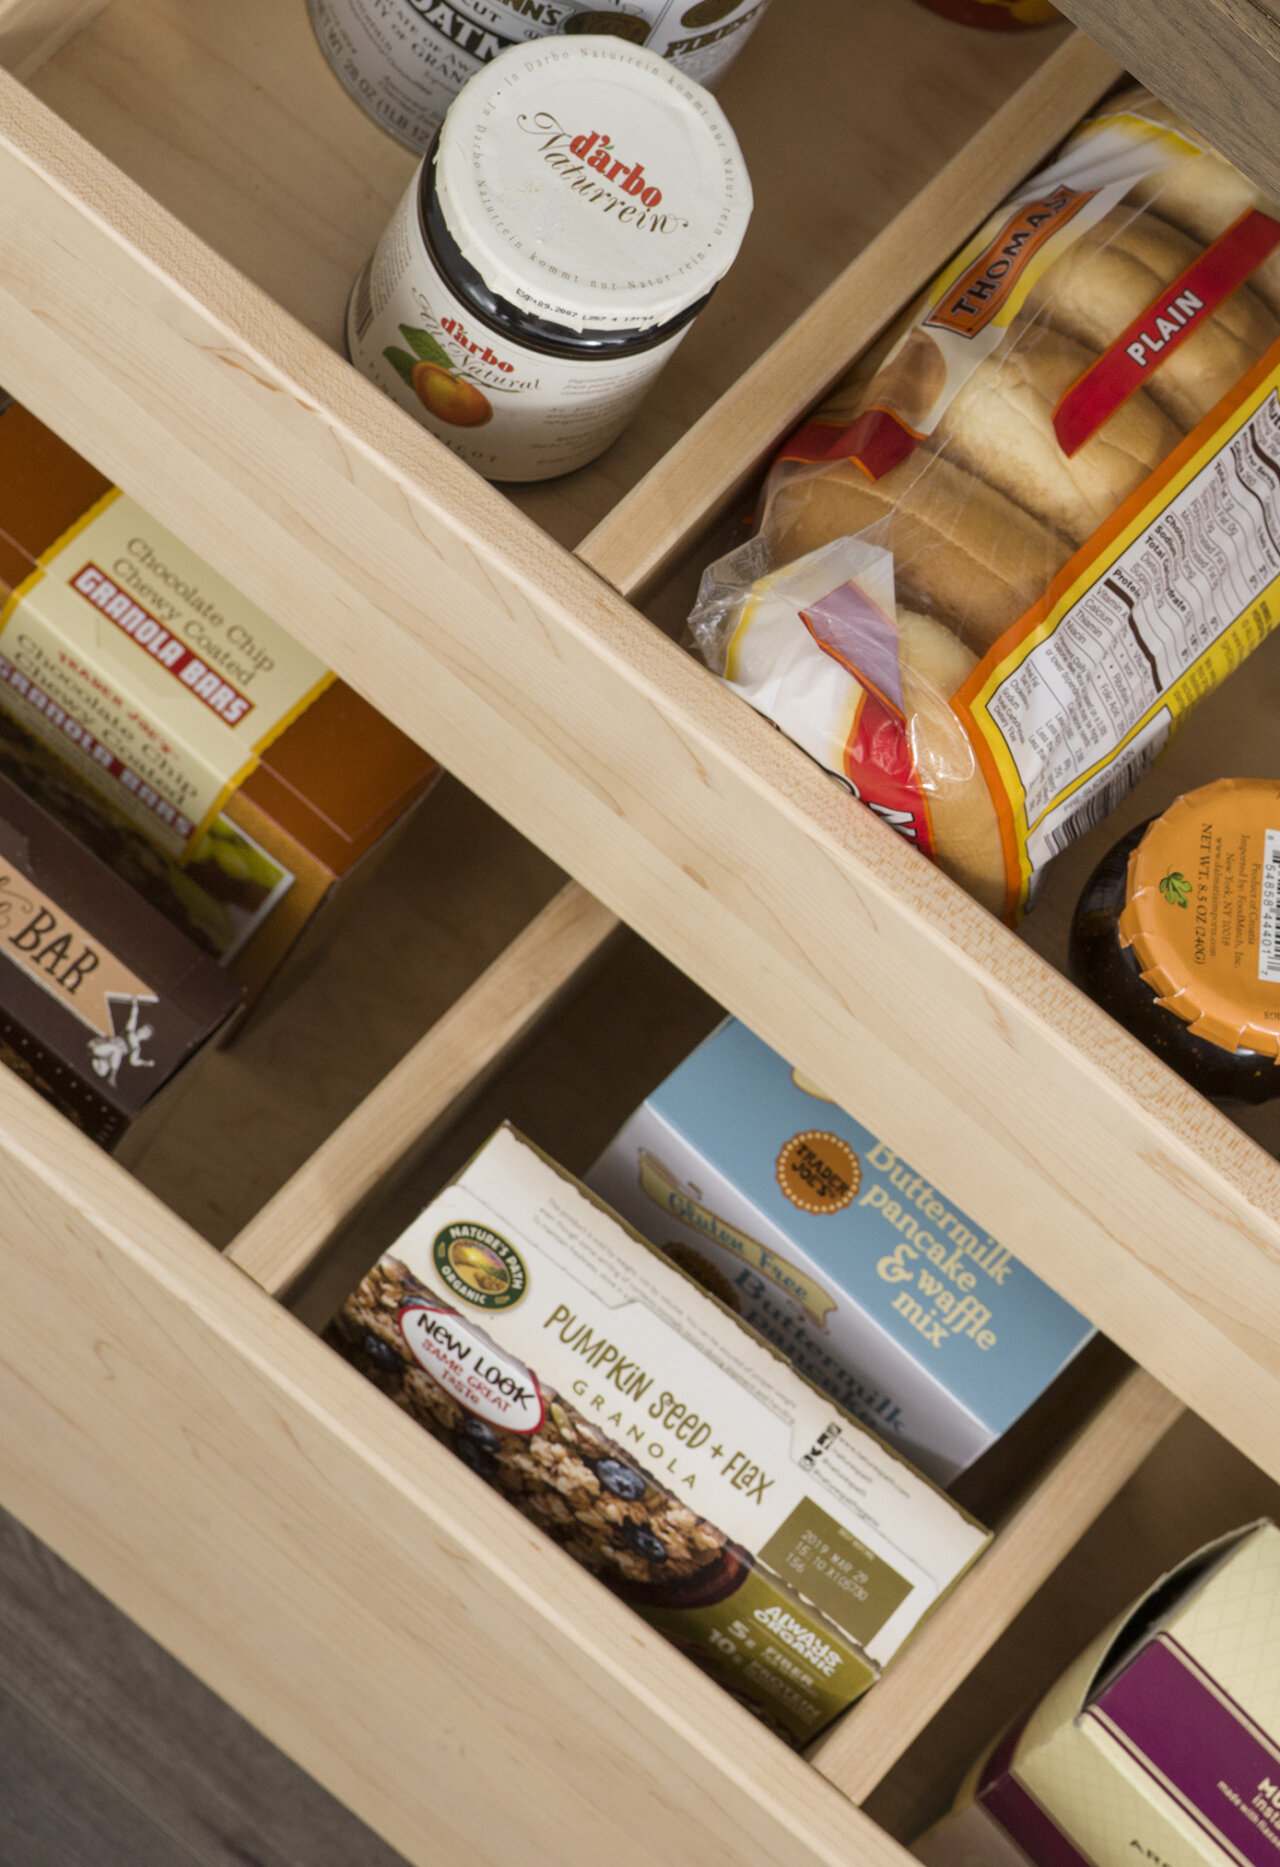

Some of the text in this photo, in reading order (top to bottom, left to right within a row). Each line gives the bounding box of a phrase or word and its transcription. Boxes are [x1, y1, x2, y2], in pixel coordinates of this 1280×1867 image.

[1126, 288, 1205, 367] PLAIN
[112, 557, 257, 687] Chewy Coated
[126, 536, 276, 674] Chocolate Chip
[57, 651, 124, 709] TRADER
[73, 566, 250, 724] GRANOLA BARS
[16, 633, 199, 798] Chocolate Chip
[119, 769, 190, 837] BARS
[1224, 852, 1235, 873] New
[1237, 833, 1250, 877] Imported
[1193, 822, 1212, 964] NET WT. 8.5 OZ (240G)
[1222, 901, 1231, 916] NY
[1248, 862, 1260, 945] Product of Croatia
[1260, 863, 1275, 955] 54858 44401
[8, 905, 101, 995] BAR
[1221, 920, 1230, 945] 10018
[795, 1141, 851, 1198] TRADER
[667, 1191, 809, 1300] Gluten Free
[858, 1183, 978, 1293] pancake
[865, 1140, 1014, 1287] Buttermilk
[439, 1264, 488, 1306] ORGANIC
[449, 1224, 525, 1292] NATURE'S PATH
[876, 1242, 998, 1351] & waffle
[891, 1291, 951, 1349] mix
[472, 1356, 537, 1411] LOOK
[733, 1267, 906, 1434] Buttermilk
[465, 1372, 513, 1414] GREAT
[571, 1379, 698, 1491] GRANOLA
[801, 1529, 831, 1554] 2019
[752, 1608, 837, 1678] ORGANIC
[763, 1605, 845, 1668] ALWAYS
[1216, 1779, 1243, 1808] made
[1238, 1802, 1261, 1827] with
